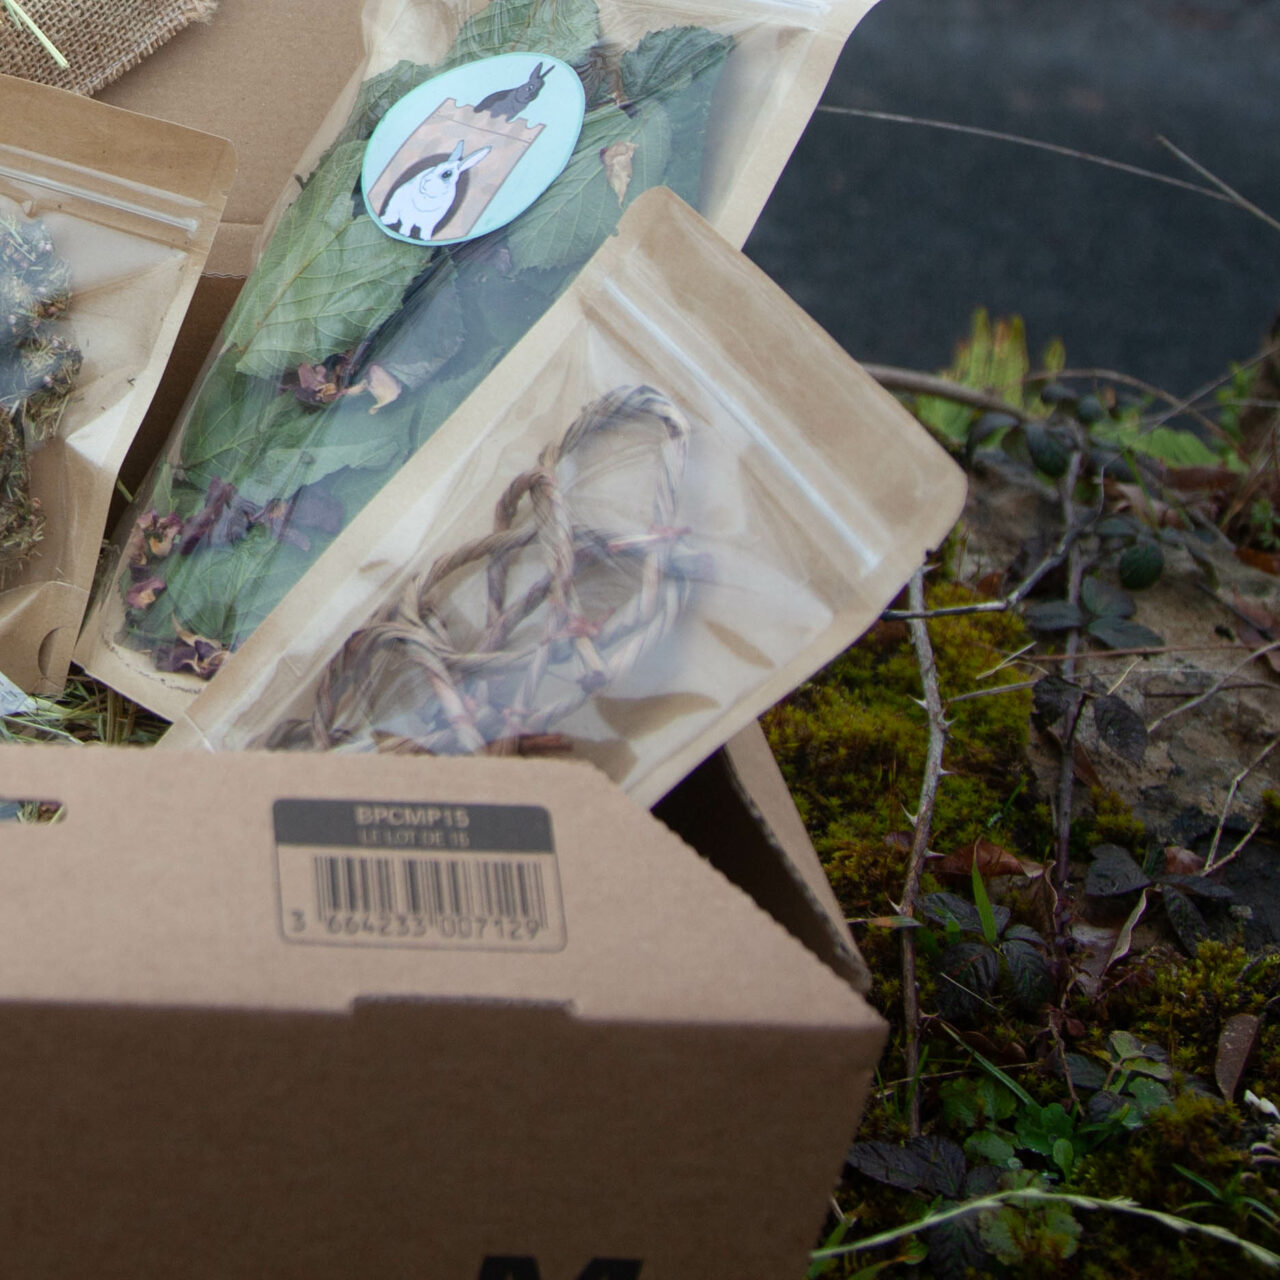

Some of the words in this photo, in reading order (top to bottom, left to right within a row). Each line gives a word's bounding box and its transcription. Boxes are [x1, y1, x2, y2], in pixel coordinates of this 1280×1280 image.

[355, 806, 470, 828] BPCMP15
[420, 829, 446, 846] DE
[291, 909, 307, 934] 3
[326, 913, 428, 938] 664233
[438, 917, 539, 941] 007129
